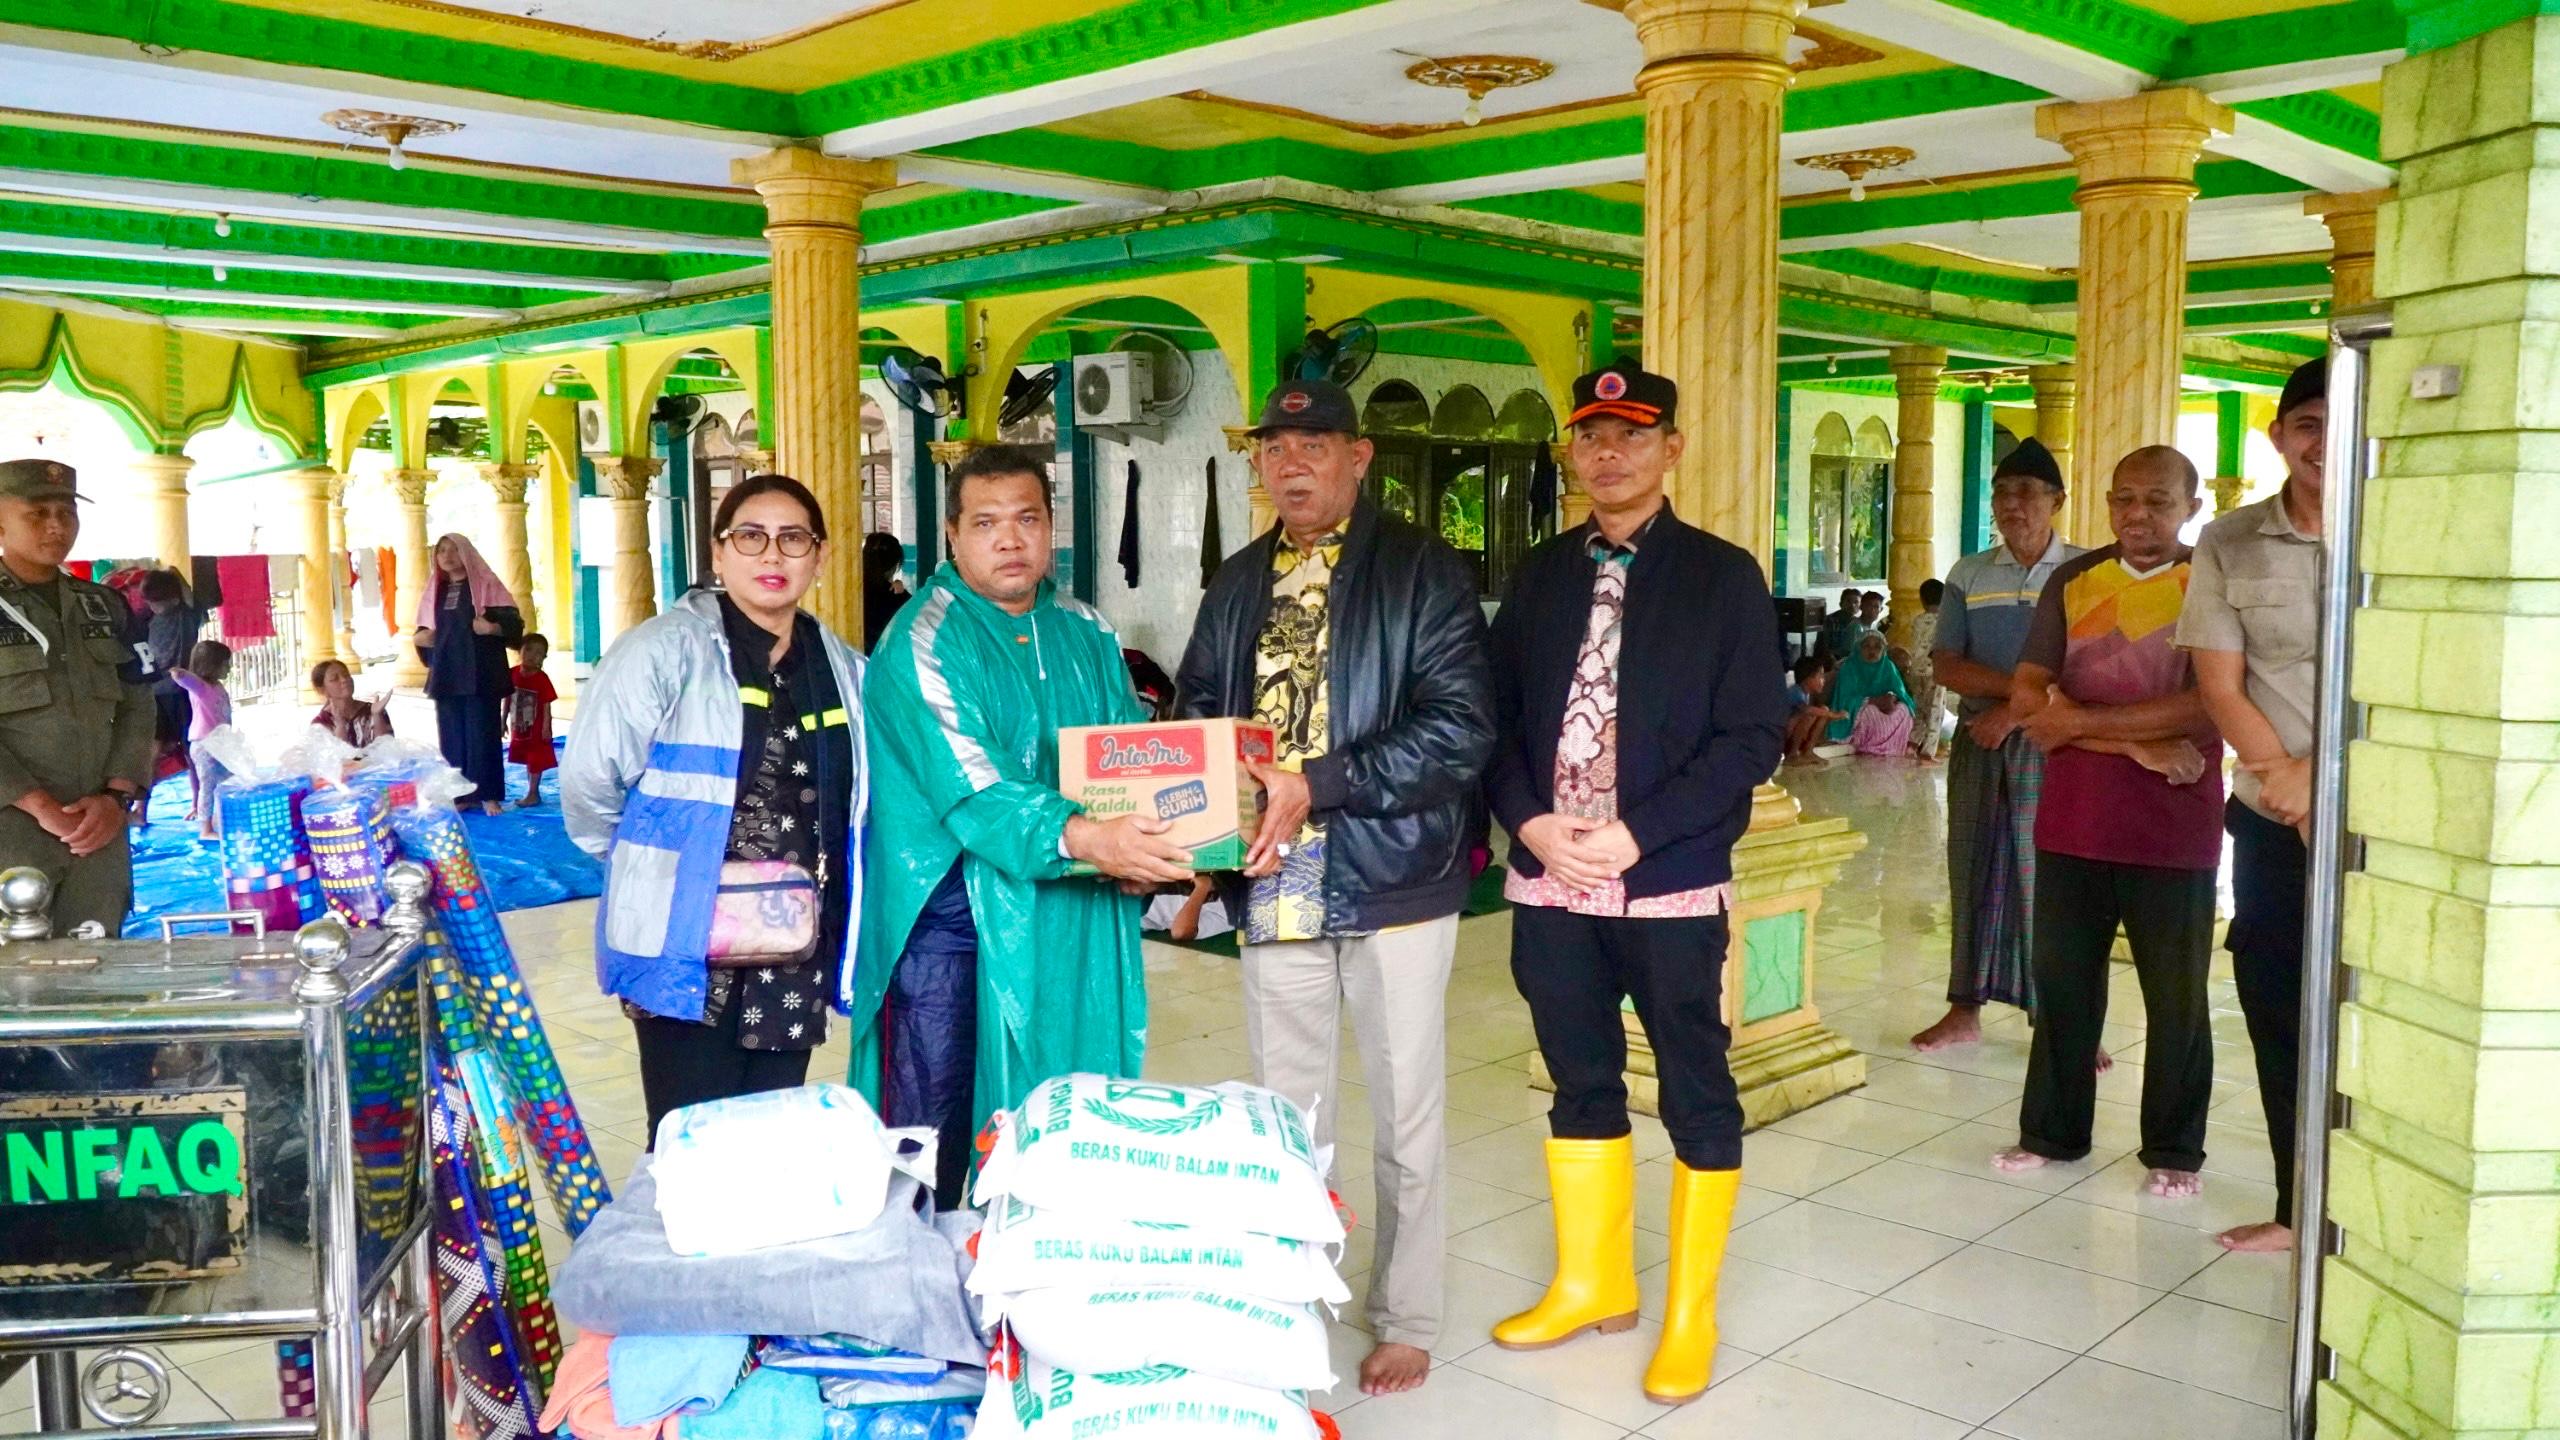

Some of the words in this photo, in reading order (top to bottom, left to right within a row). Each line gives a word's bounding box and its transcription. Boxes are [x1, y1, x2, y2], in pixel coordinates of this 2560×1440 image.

[1100, 736, 1192, 771] InterMi
[1082, 784, 1127, 797] Rasa
[1084, 798, 1137, 814] Kaldu
[1160, 793, 1206, 818] GURIH
[1163, 786, 1194, 805] LEBIH
[0, 1121, 243, 1203] NFAQ
[1070, 1141, 1120, 1162] BERAS
[1126, 1147, 1170, 1171] KUKU
[1175, 1155, 1229, 1177] BALAM
[1234, 1162, 1280, 1185] INTAN
[1034, 1239, 1083, 1260] BERAS
[1089, 1243, 1134, 1263] KUKU
[1139, 1245, 1193, 1265] BALAM
[1198, 1247, 1243, 1269] INTAN
[1088, 1291, 1140, 1305] BERAS
[1193, 1291, 1248, 1313] BALAM
[1247, 1304, 1294, 1330] INTAN
[1071, 1409, 1121, 1440] BERAS
[1126, 1401, 1170, 1425] KUKU
[1176, 1401, 1230, 1424] BALAM
[1233, 1408, 1278, 1435] INTAN
